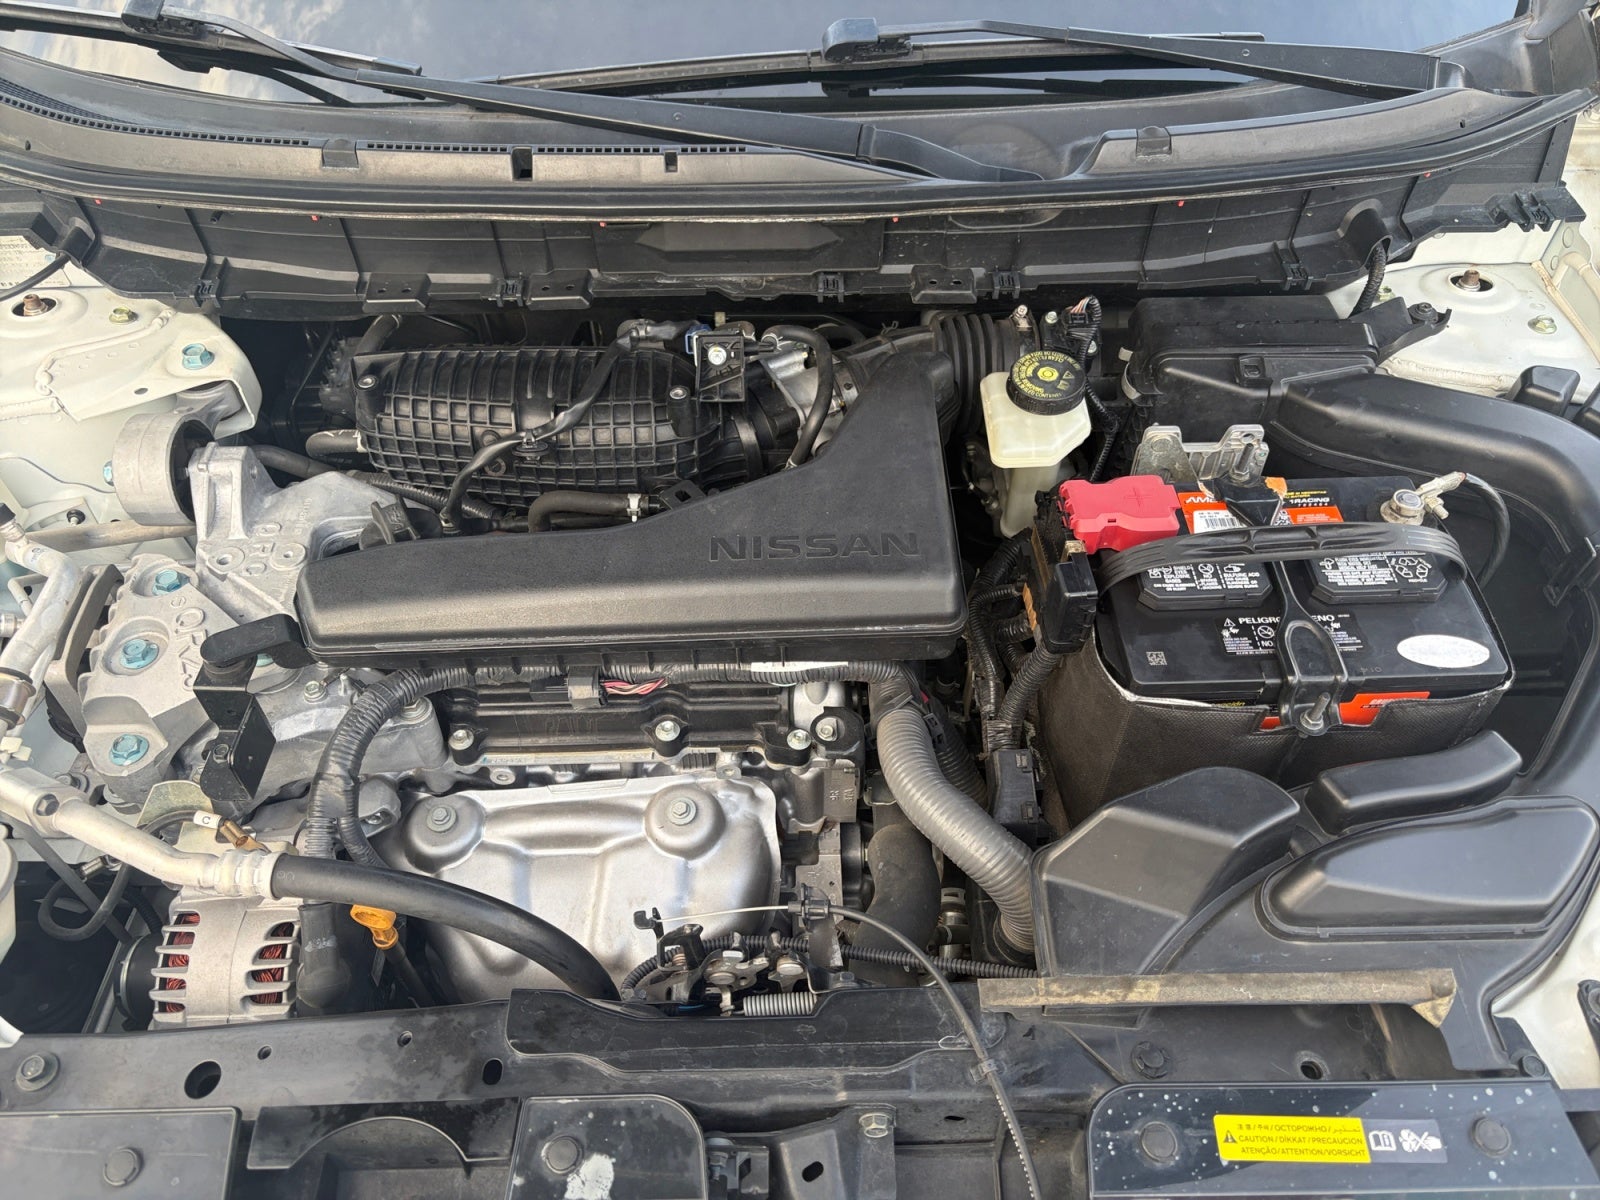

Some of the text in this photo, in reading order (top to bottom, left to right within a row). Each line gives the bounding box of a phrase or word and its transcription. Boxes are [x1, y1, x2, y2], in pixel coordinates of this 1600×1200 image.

[709, 532, 920, 562] NISSAN
[202, 816, 210, 824] C
[1238, 1135, 1274, 1143] CAUTION
